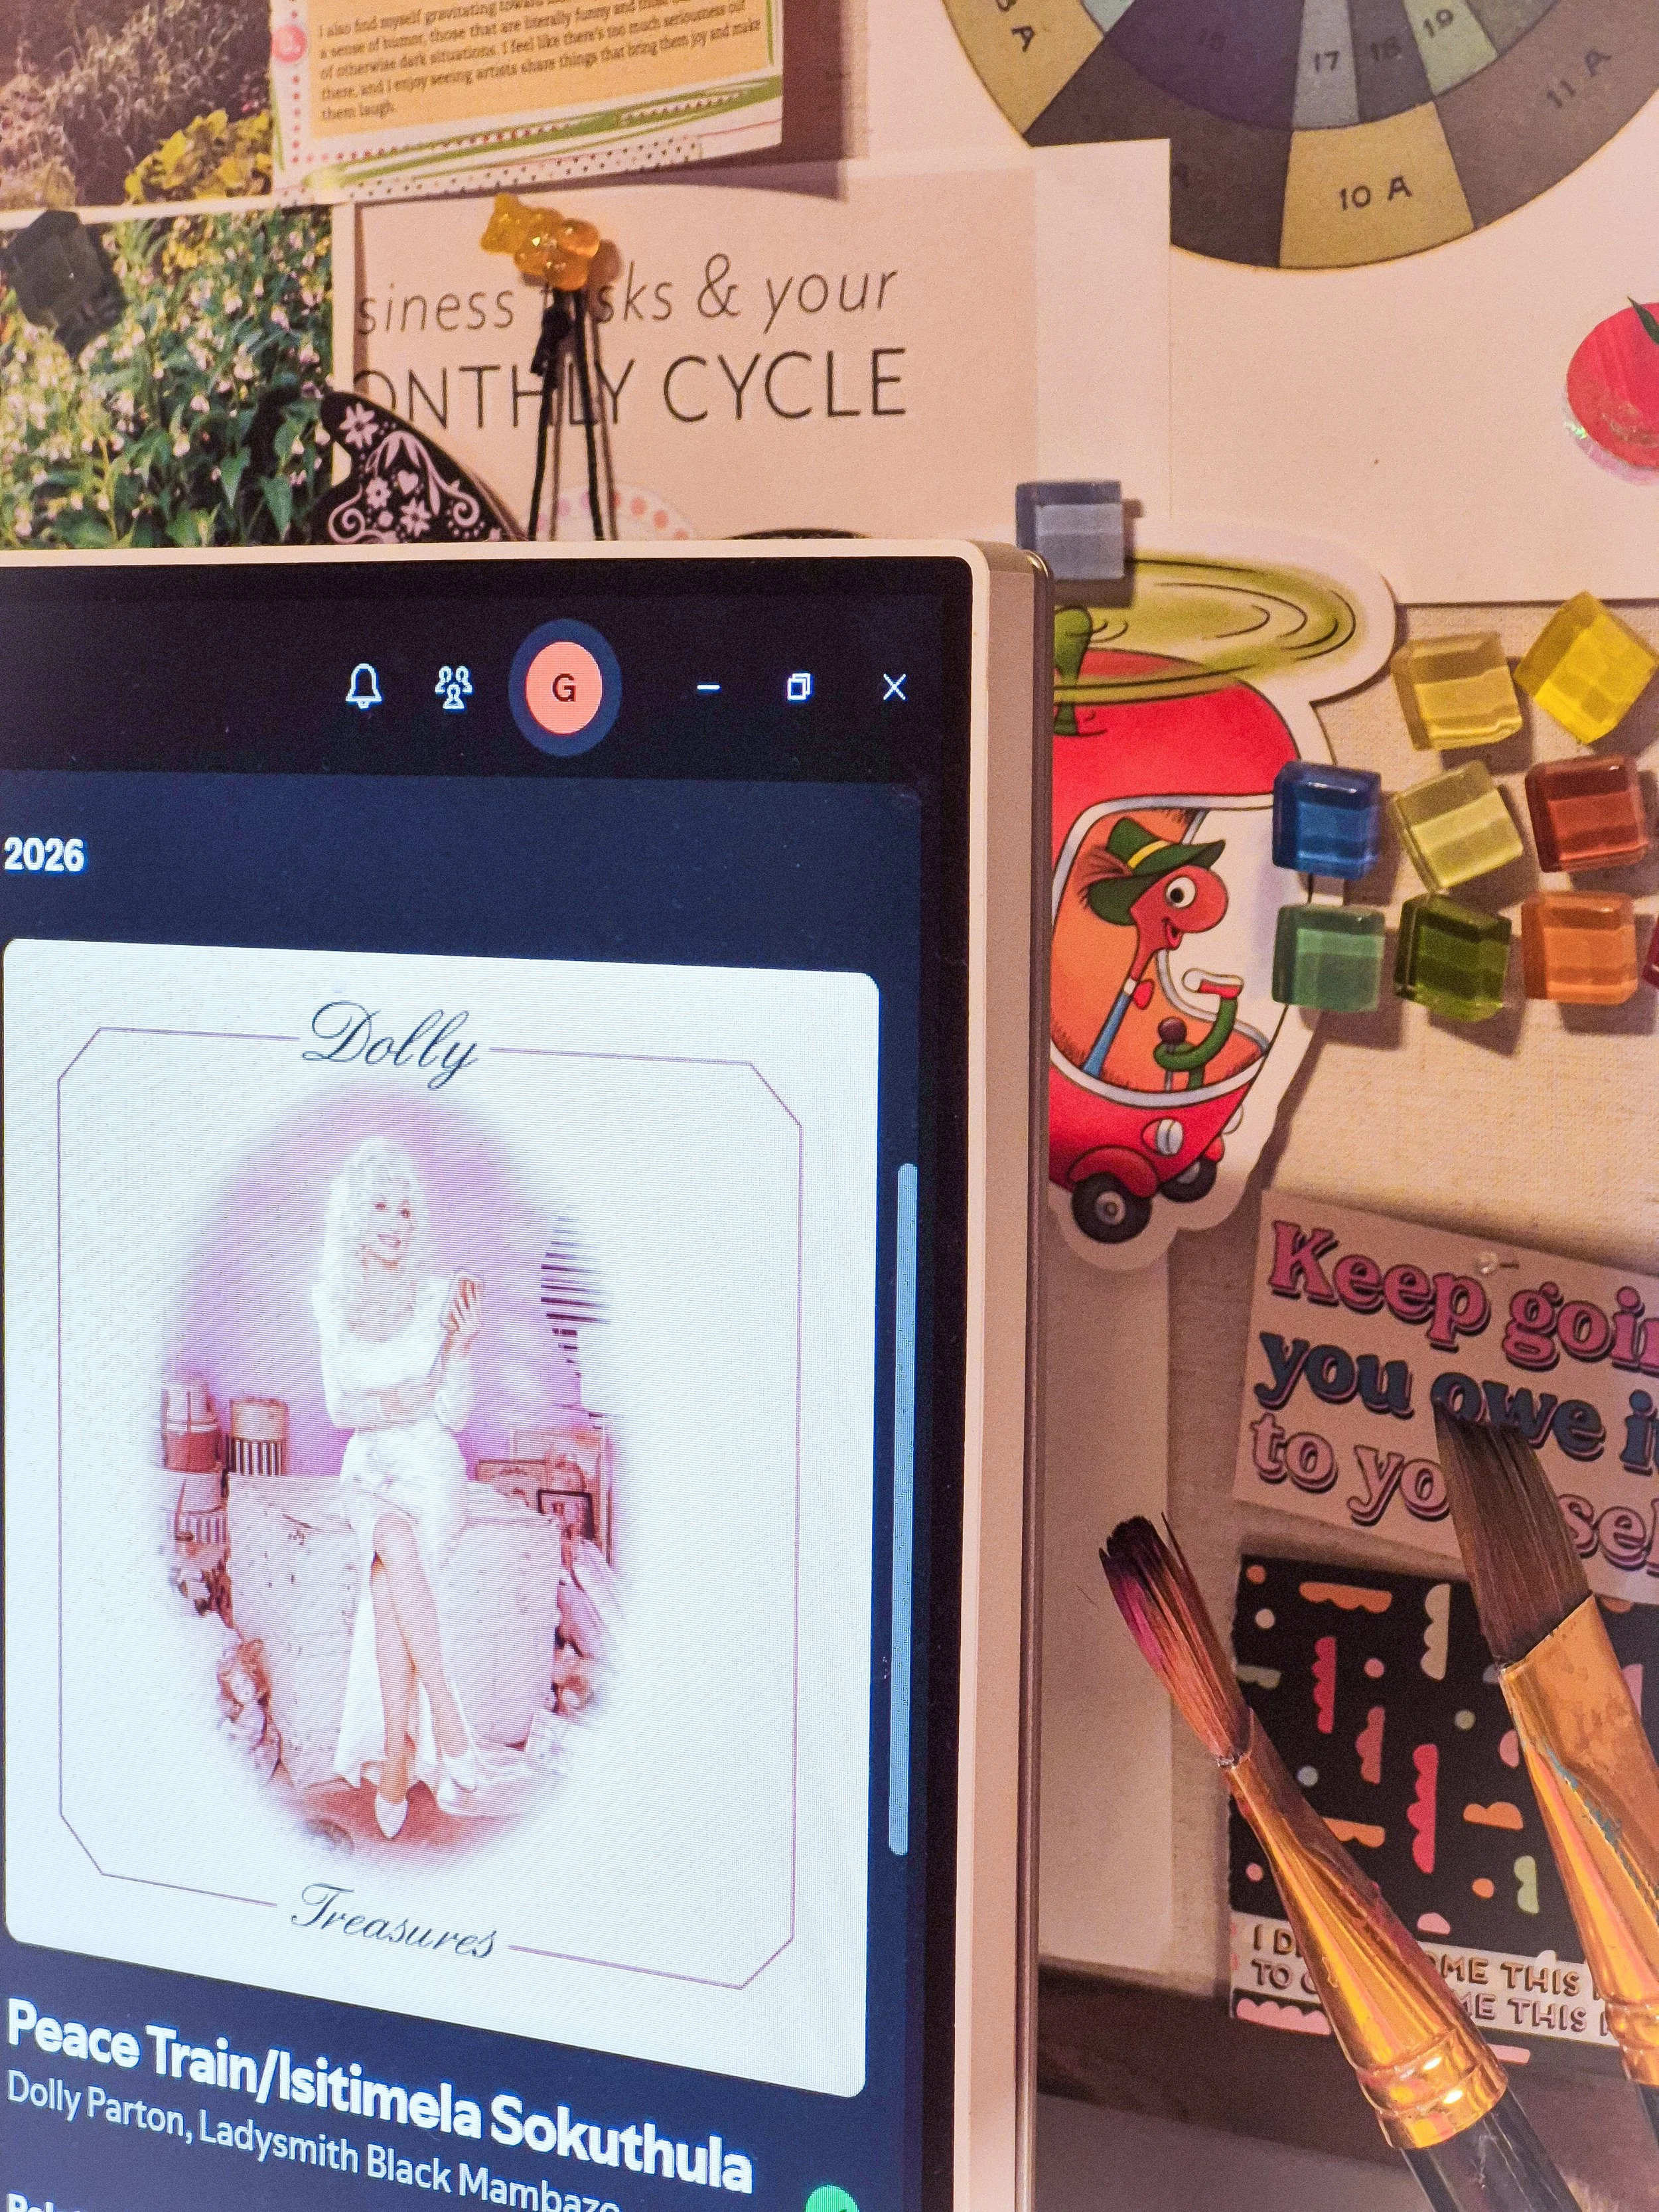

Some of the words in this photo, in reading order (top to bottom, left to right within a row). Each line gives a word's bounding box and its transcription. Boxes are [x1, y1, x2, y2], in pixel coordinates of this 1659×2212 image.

[320, 65, 333, 80] of
[336, 58, 397, 78] otherwise
[398, 52, 427, 69] dark
[510, 37, 535, 54] feel
[537, 33, 560, 50] like
[563, 29, 606, 46] there's
[607, 25, 627, 39] too
[630, 15, 662, 34] much
[664, 5, 727, 28] seriousness
[368, 37, 380, 51] of
[431, 27, 465, 42] those
[469, 23, 498, 38] that
[500, 19, 522, 34] are
[381, 9, 423, 30] myself
[425, 2, 497, 25] gravitating
[1011, 25, 1035, 52] A
[1422, 9, 1455, 38] 19
[360, 78, 385, 97] and
[394, 75, 429, 93] enjoy
[431, 69, 473, 86] seeing
[475, 63, 518, 81] artists
[521, 57, 556, 76] share
[559, 52, 598, 69] things
[600, 45, 624, 62] that
[627, 41, 658, 58] bring
[660, 35, 689, 52] them
[691, 31, 708, 48] joy
[709, 22, 729, 41] and
[732, 17, 762, 37] make
[1313, 50, 1340, 73] 17
[1546, 79, 1577, 109] 11
[1585, 48, 1613, 76] A
[321, 106, 357, 121] them
[1338, 185, 1372, 211] 10
[1388, 175, 1413, 201] A
[697, 252, 742, 319] &
[763, 269, 899, 334] your
[663, 346, 907, 423] CYCLE
[551, 673, 579, 703] G
[3, 836, 87, 873] 2026
[302, 1000, 479, 1090] Dolly
[1269, 1220, 1491, 1353] Keep
[1254, 1331, 1414, 1420] you
[1431, 1371, 1606, 1462] owe
[1619, 1388, 1659, 1477] i
[1250, 1412, 1338, 1494] to
[289, 1882, 498, 1958] Treasures
[1251, 1958, 1293, 1990] TO
[1507, 1998, 1588, 2033] THIS
[1253, 1924, 1263, 1951] I
[1500, 1961, 1581, 1997] THIS
[7, 1998, 141, 2069] Peace
[144, 2024, 482, 2140] Train/Isitimela
[490, 2093, 754, 2194] Sokuthula
[7, 2069, 82, 2122] Dolly
[88, 2086, 193, 2145] Parton,
[199, 2109, 359, 2174] Ladysmith
[367, 2143, 453, 2193] Black
